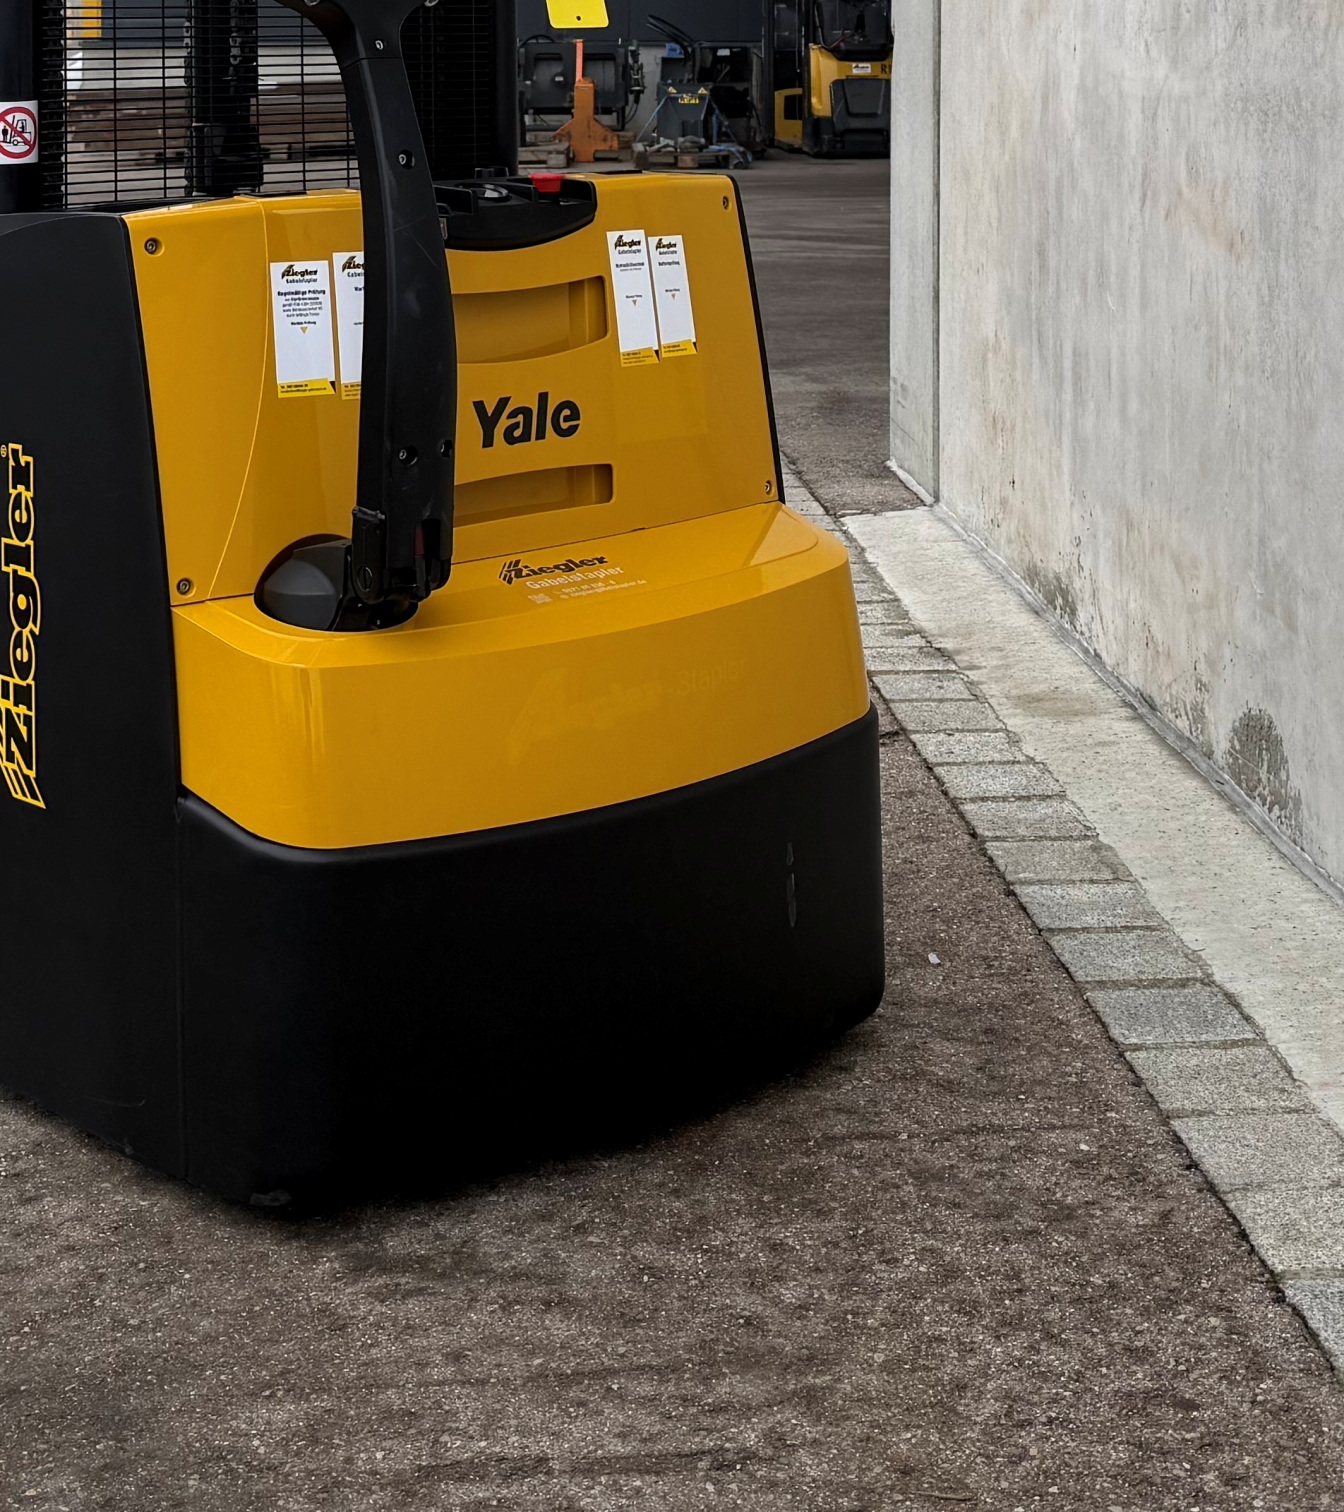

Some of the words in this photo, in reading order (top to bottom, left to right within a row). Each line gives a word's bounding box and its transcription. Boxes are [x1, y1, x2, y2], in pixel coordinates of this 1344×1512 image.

[282, 264, 318, 279] Ziegler
[472, 391, 581, 449] Yale
[498, 555, 609, 586] Ziegler
[525, 566, 625, 590] Gabelstapler
